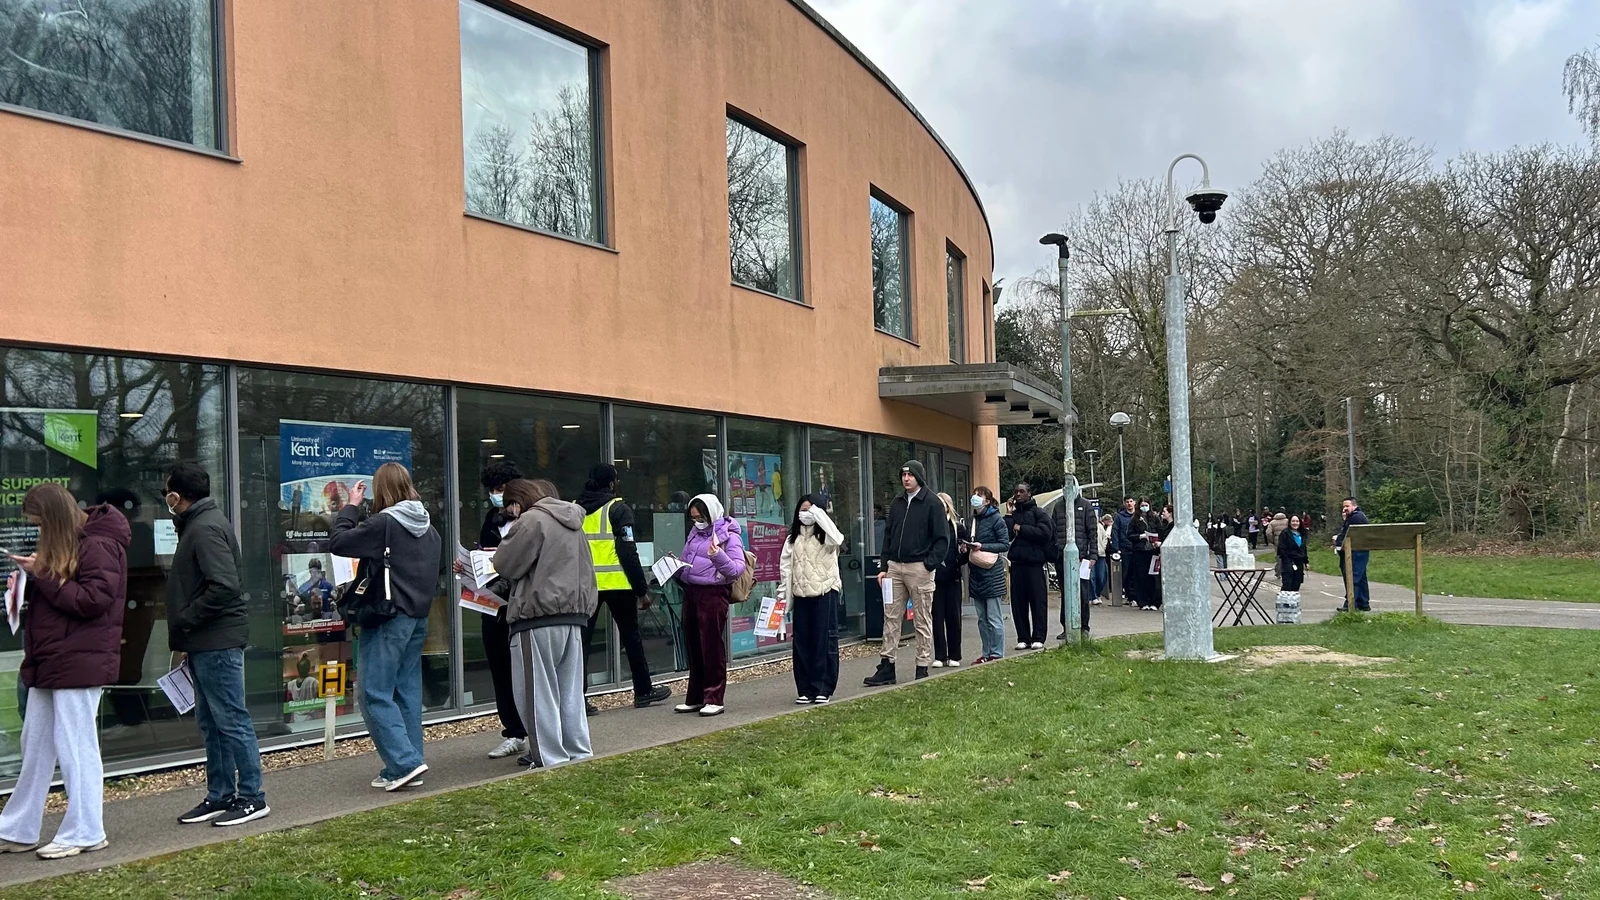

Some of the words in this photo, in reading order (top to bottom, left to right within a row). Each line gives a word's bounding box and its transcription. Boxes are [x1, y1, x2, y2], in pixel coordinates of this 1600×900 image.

[58, 431, 83, 443] Kent
[291, 442, 320, 457] Kent
[326, 447, 356, 458] SPORT
[0, 493, 25, 505] ICE
[765, 526, 780, 536] Active
[322, 666, 342, 695] H
